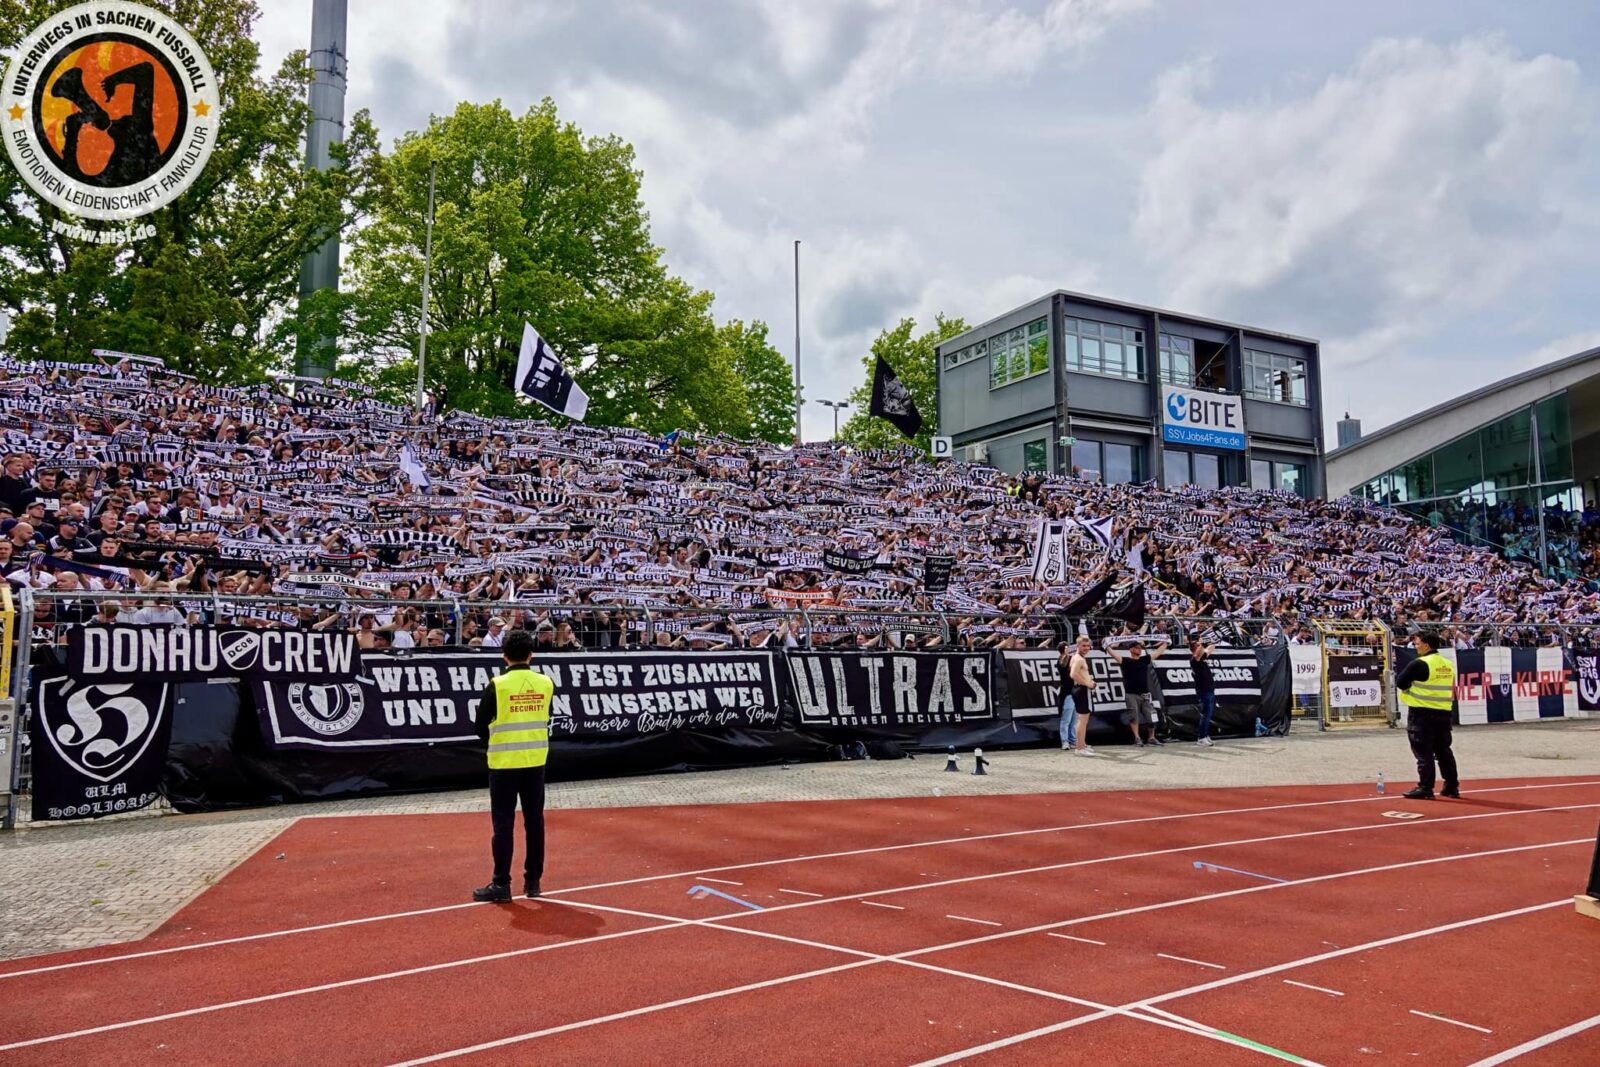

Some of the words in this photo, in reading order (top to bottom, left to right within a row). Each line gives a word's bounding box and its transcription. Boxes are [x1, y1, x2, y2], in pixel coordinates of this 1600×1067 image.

[1189, 398, 1236, 428] BITE
[936, 440, 948, 454] D
[826, 554, 848, 567] SSV
[83, 628, 218, 673] DONAU
[262, 631, 354, 674] CREW
[1296, 663, 1316, 674] 1999
[1577, 655, 1597, 668] SSV
[372, 666, 441, 693] WIR
[568, 664, 634, 687] FEST
[641, 662, 762, 687] ZUSAMMEN
[1579, 667, 1599, 679] 1846
[791, 656, 986, 716] ULTRAS
[1345, 687, 1367, 696] Vinko
[1516, 669, 1573, 698] KURVE
[382, 698, 457, 727] UND
[580, 687, 708, 716] UNSEREN
[714, 686, 765, 708] WEG
[510, 704, 545, 713] SECURITY
[547, 715, 578, 737] Für
[584, 717, 631, 732] unsere
[637, 709, 686, 733] Brüder
[689, 710, 713, 725] vor
[715, 708, 740, 726] den
[831, 714, 888, 726] BROKEN
[896, 713, 963, 725] SOCIETY
[85, 782, 128, 799] ULM
[48, 791, 158, 819] HOOLIGANS
